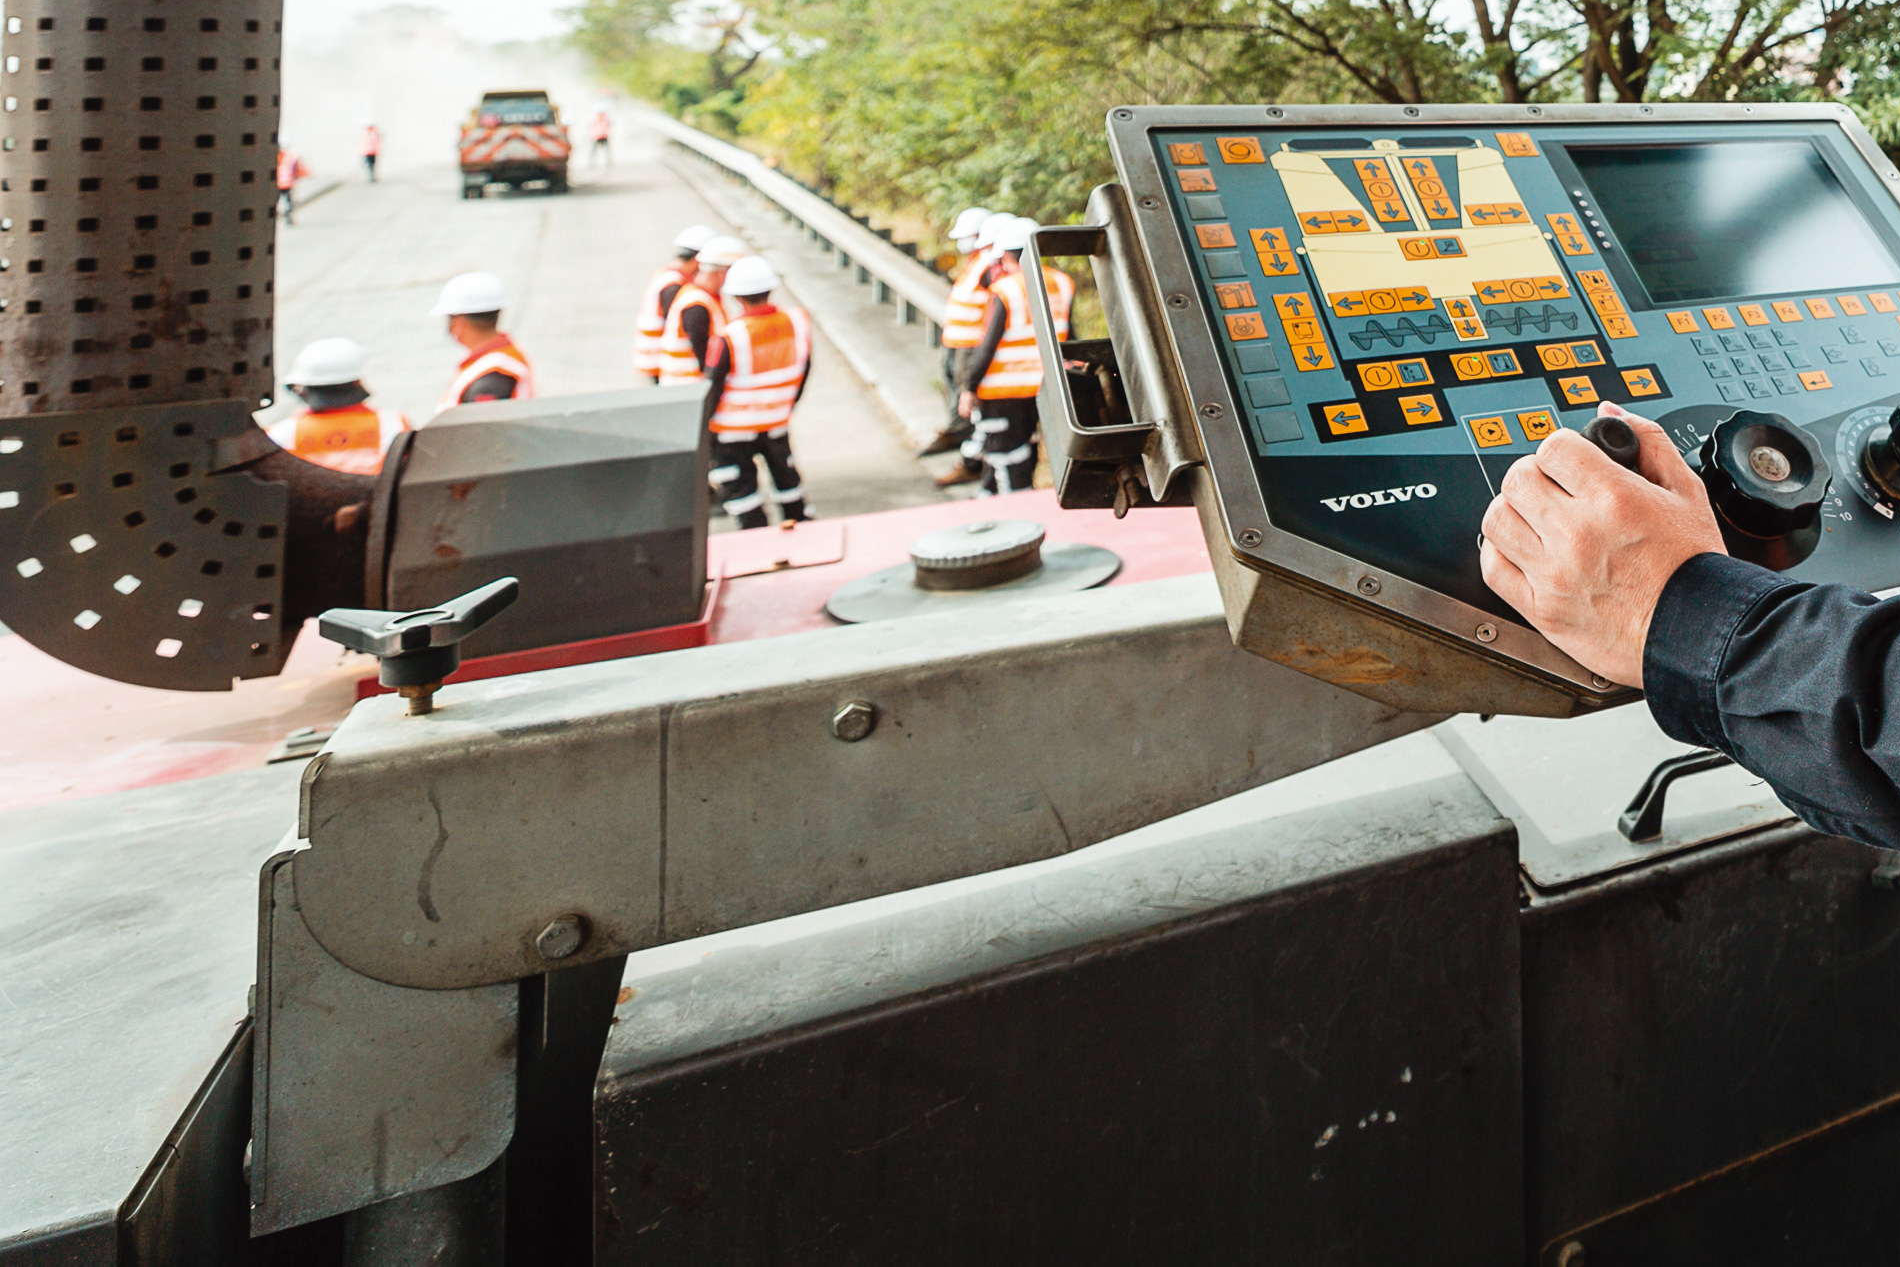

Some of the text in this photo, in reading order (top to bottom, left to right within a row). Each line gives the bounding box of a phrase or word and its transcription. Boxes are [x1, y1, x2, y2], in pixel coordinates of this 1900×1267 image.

[1747, 310, 1761, 320] F3
[1781, 307, 1795, 316] F4
[1676, 317, 1691, 327] F1
[1712, 314, 1727, 323] F2
[1722, 336, 1731, 344] 8
[1749, 333, 1757, 342] 9
[1694, 339, 1702, 347] 7
[1735, 359, 1744, 367] 5
[1762, 355, 1771, 364] 6
[1748, 382, 1757, 391] 2
[1775, 378, 1784, 387] 3
[1722, 386, 1730, 394] 1
[1686, 423, 1696, 433] 0
[1319, 483, 1438, 513] VOLVO
[1834, 497, 1843, 507] 9
[1839, 511, 1853, 522] 10
